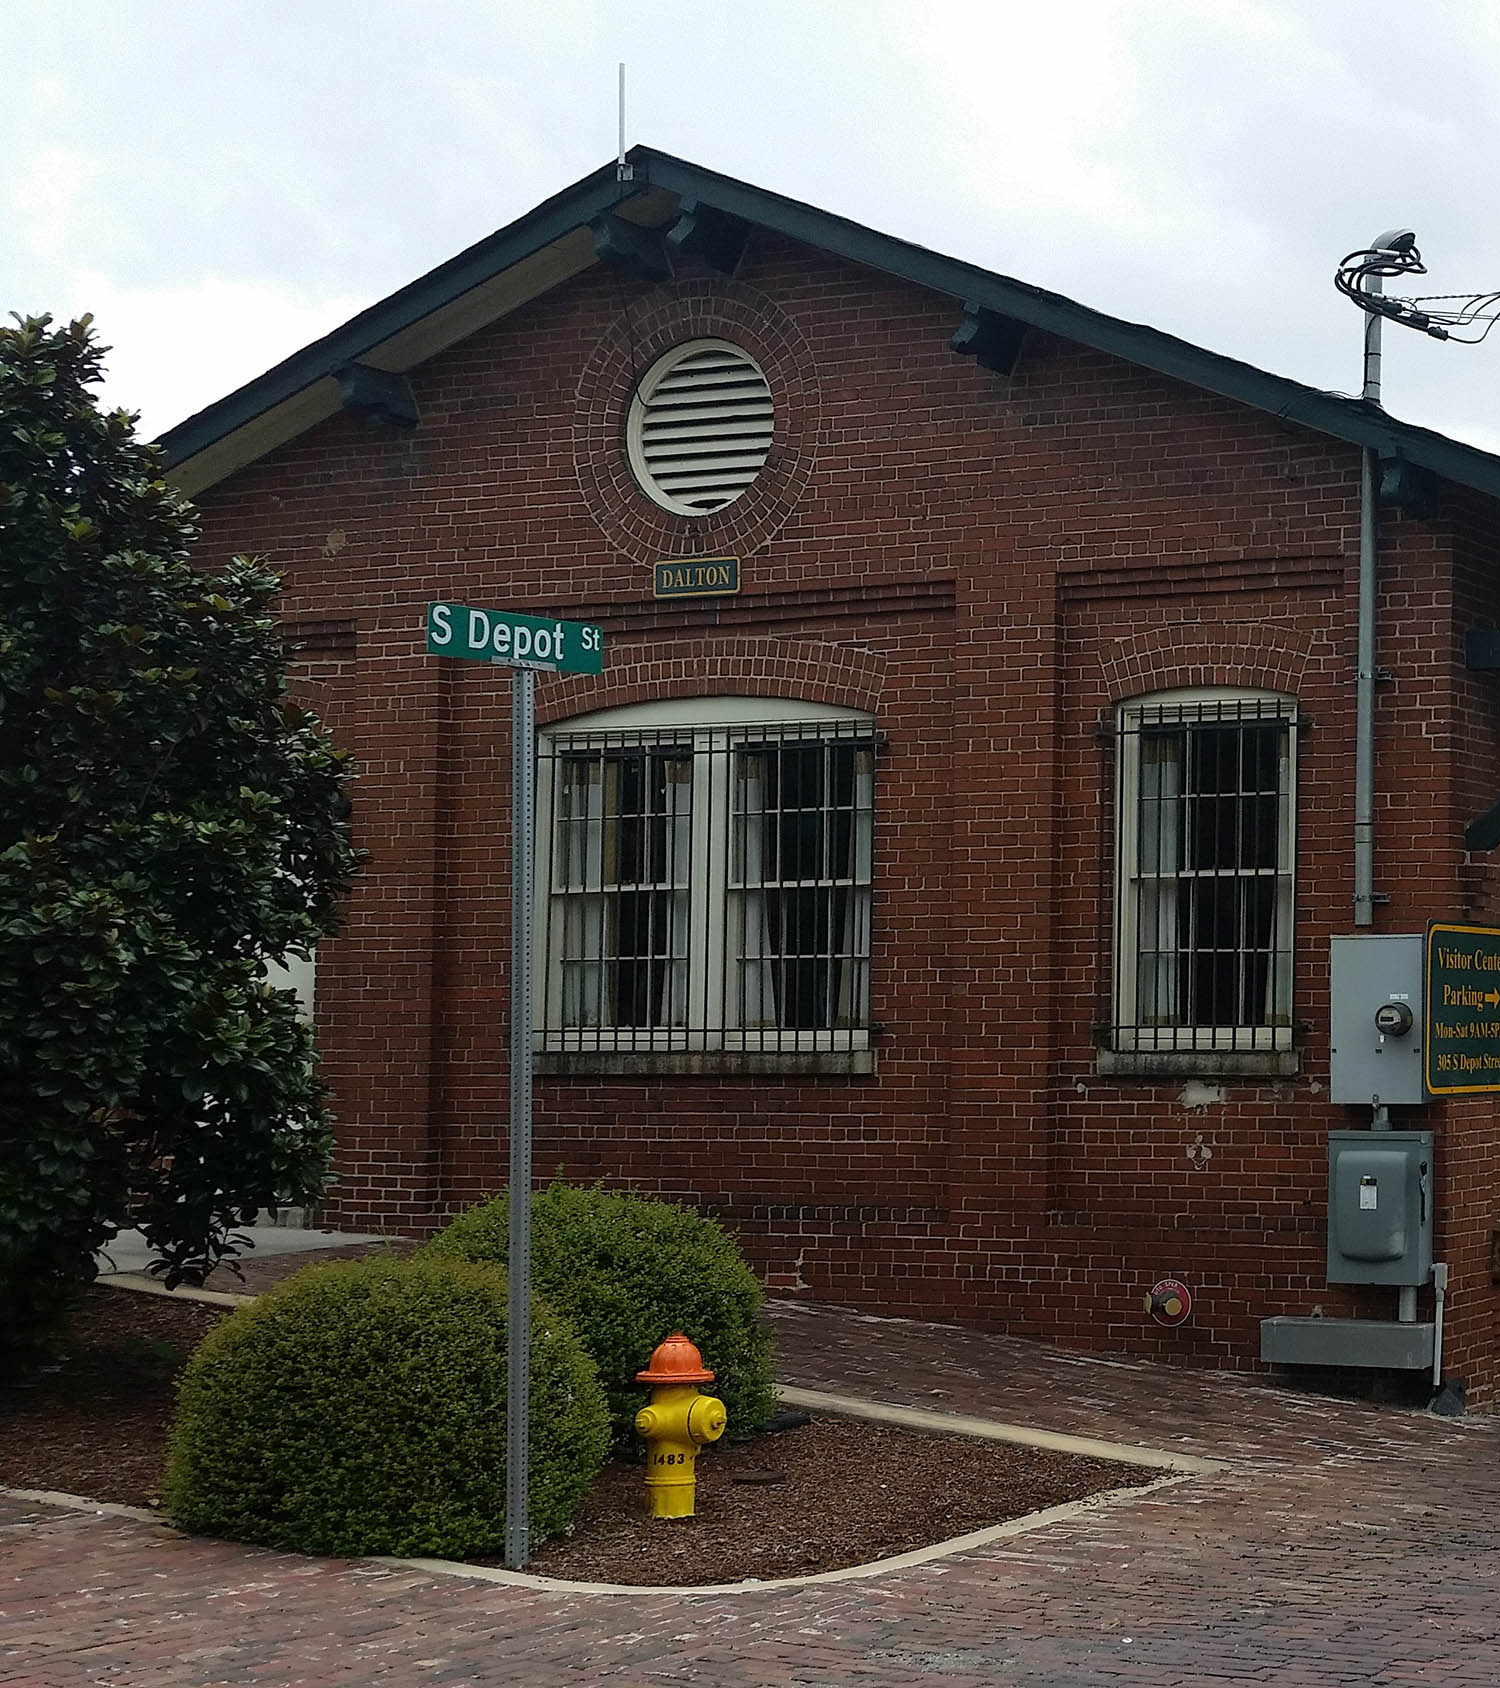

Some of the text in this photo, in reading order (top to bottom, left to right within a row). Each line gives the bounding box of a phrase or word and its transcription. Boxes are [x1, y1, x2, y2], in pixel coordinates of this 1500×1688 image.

[662, 566, 731, 589] DALTON
[430, 604, 601, 661] S Depot St
[1438, 947, 1472, 970] Visitor
[1443, 984, 1485, 1012] Parking
[1435, 1023, 1469, 1040] Mon-Sat
[1436, 1054, 1452, 1071] 305
[1452, 1054, 1459, 1071] S
[1460, 1053, 1483, 1075] Depot
[653, 1453, 685, 1465] 1483
